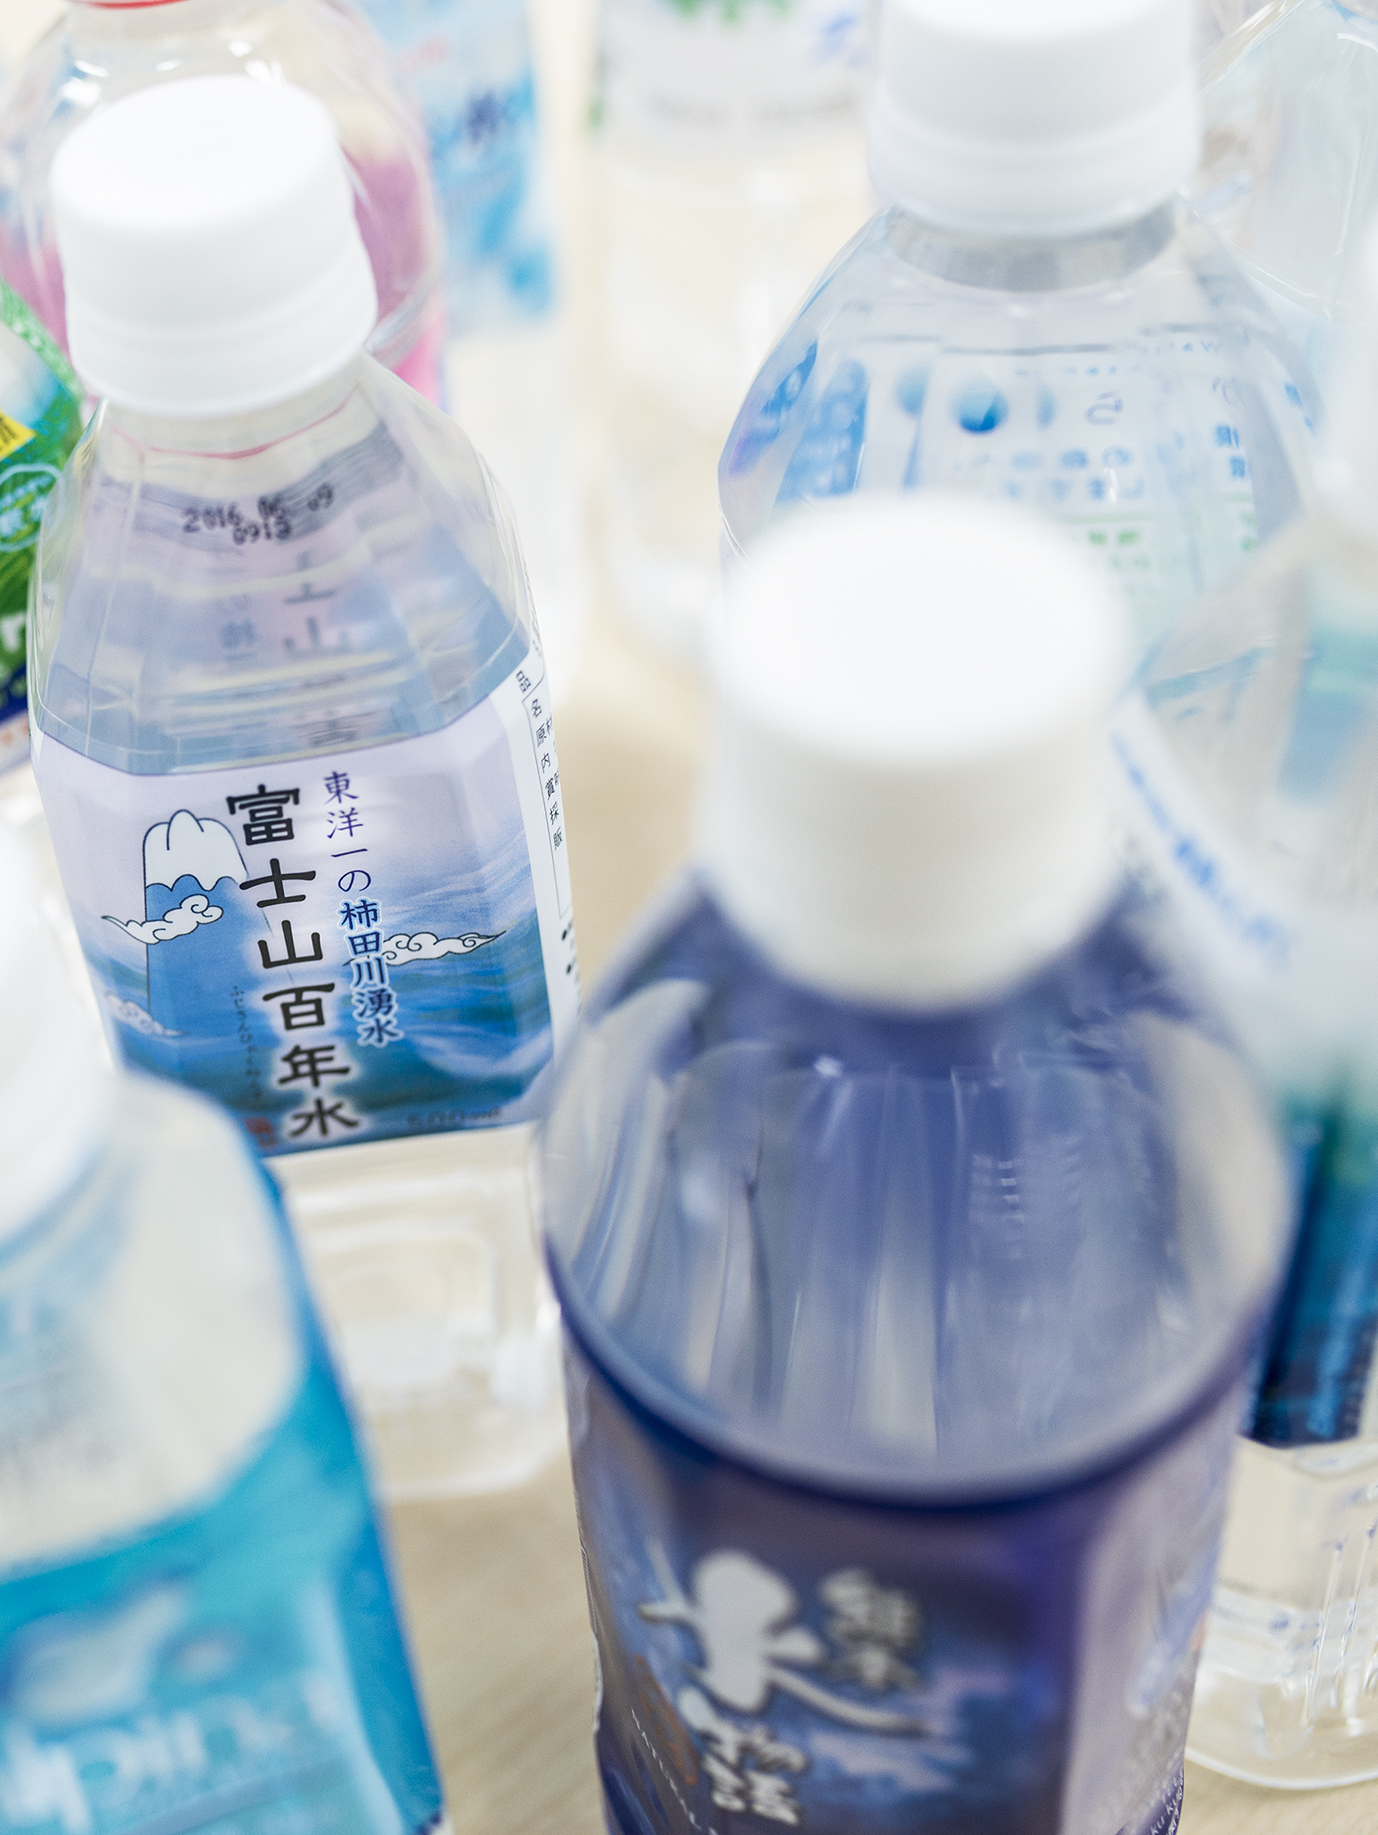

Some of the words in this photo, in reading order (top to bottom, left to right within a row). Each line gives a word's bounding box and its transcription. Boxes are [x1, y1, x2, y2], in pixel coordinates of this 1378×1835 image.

[225, 784, 359, 1139] 富士山百年水
[322, 769, 400, 1045] 東洋一の柿田川湧水
